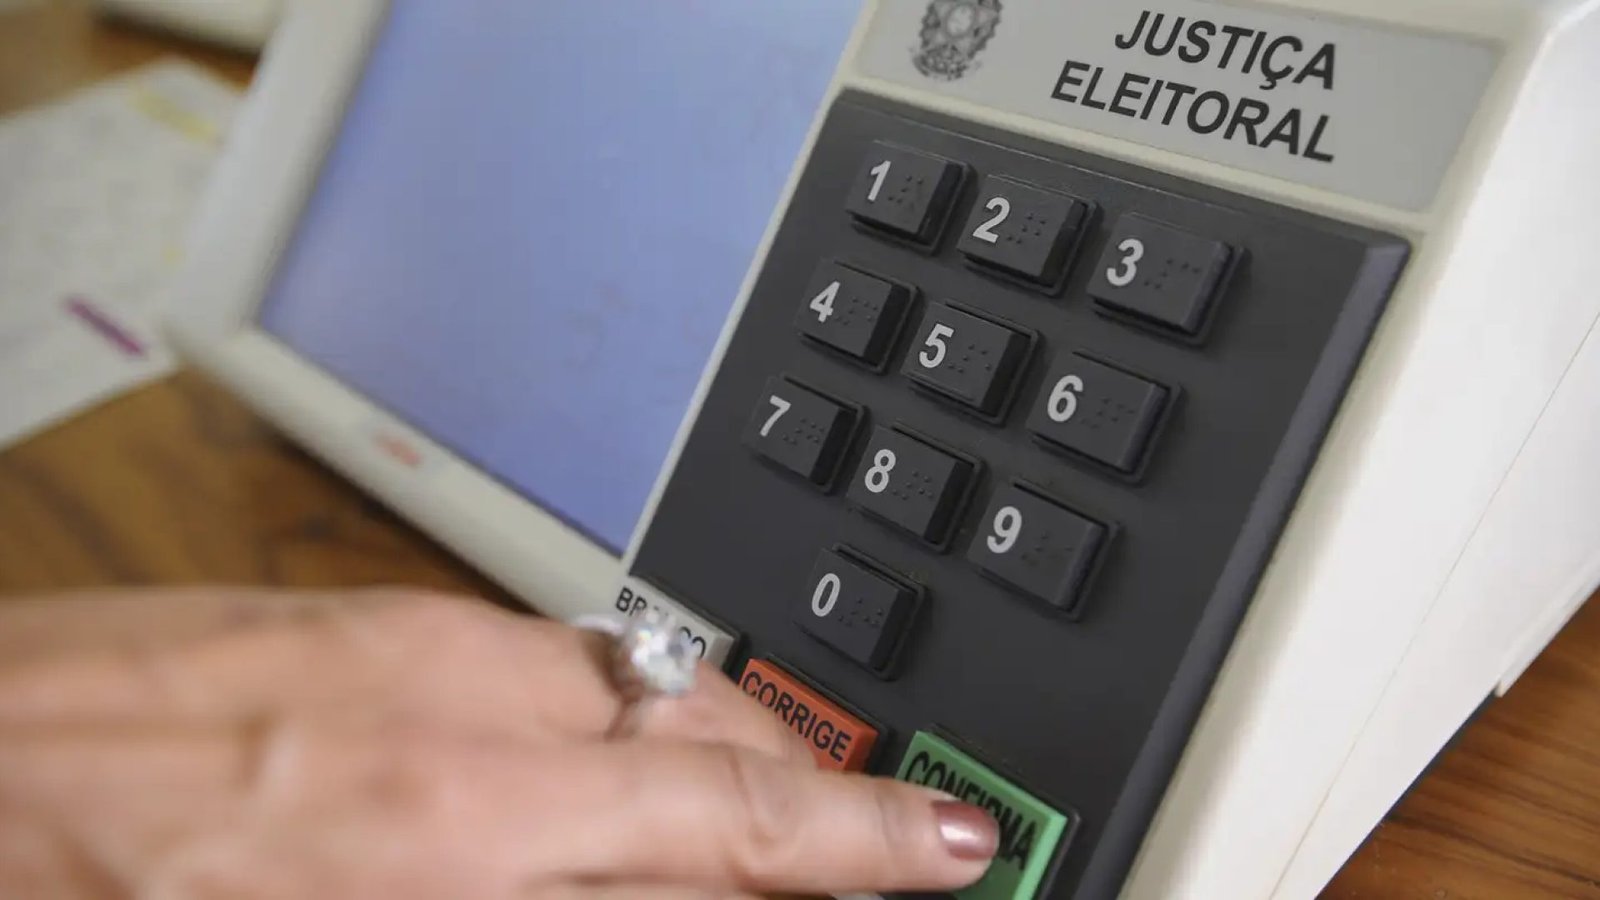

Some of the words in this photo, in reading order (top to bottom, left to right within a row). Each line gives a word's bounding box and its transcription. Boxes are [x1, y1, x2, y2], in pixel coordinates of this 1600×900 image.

[1115, 10, 1336, 91] JUSTIÇA
[1050, 59, 1335, 163] ELEITORAL
[867, 159, 892, 202] 1
[972, 196, 1011, 244] 2
[1106, 238, 1144, 287] 3
[809, 281, 841, 323] 4
[919, 323, 955, 369] 5
[759, 394, 792, 437] 7
[1047, 374, 1084, 422] 6
[864, 448, 897, 494] 8
[986, 505, 1023, 554] 9
[811, 572, 841, 617] 0
[615, 586, 707, 660] BRO
[742, 671, 852, 762] CORRIGE
